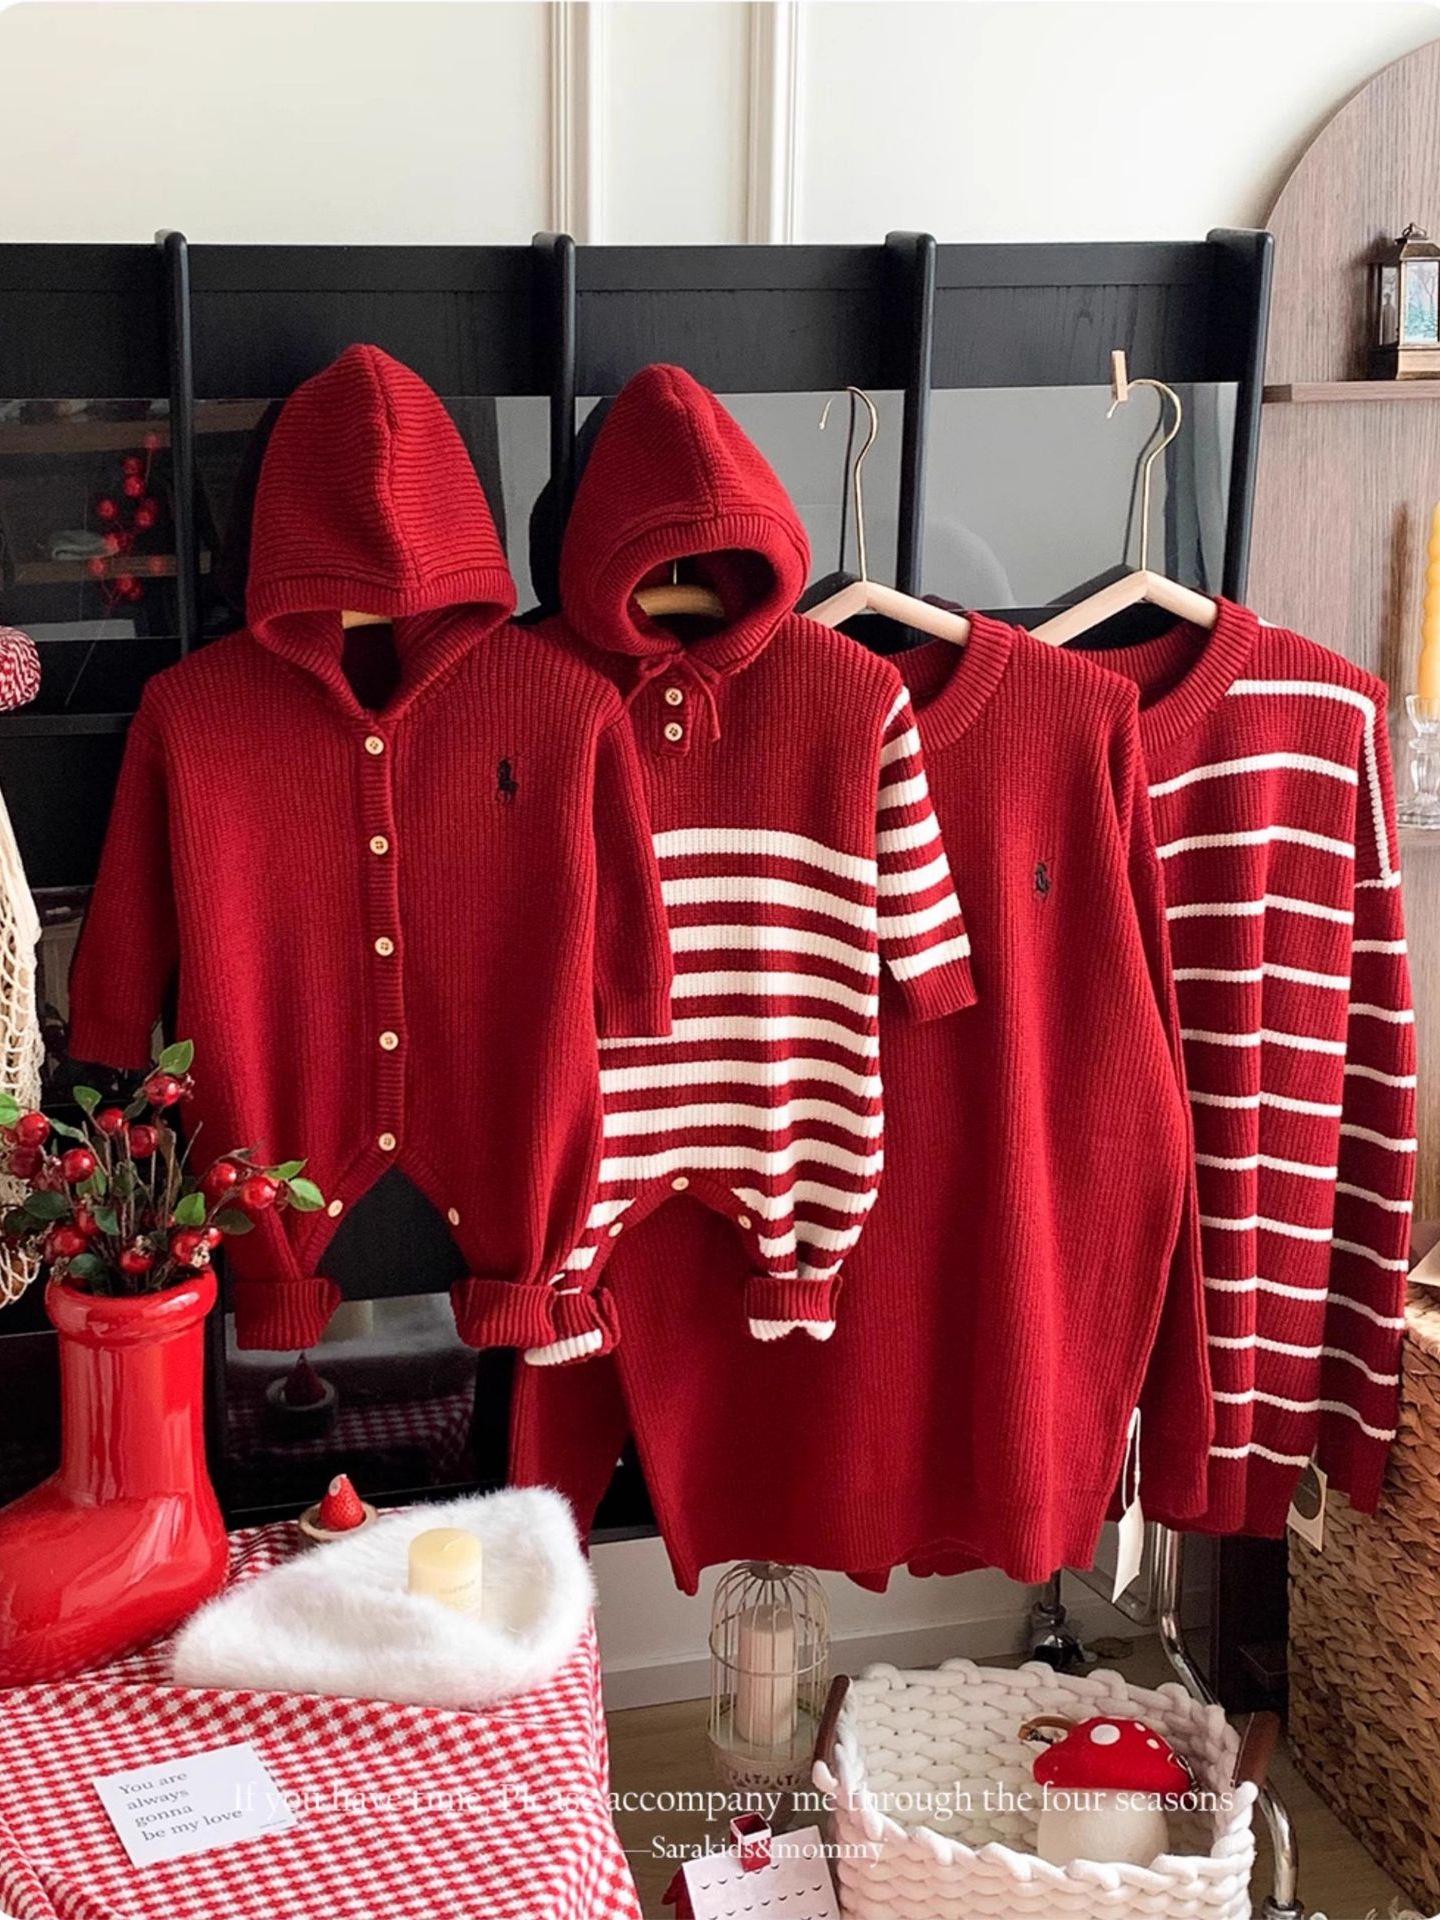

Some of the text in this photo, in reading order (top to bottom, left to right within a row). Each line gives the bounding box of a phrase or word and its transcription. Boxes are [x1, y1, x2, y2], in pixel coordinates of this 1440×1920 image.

[118, 1772, 188, 1796] You are
[127, 1789, 190, 1811] always
[134, 1804, 193, 1828] gonna
[142, 1829, 166, 1841] be
[171, 1820, 199, 1835] my
[204, 1809, 243, 1827] love
